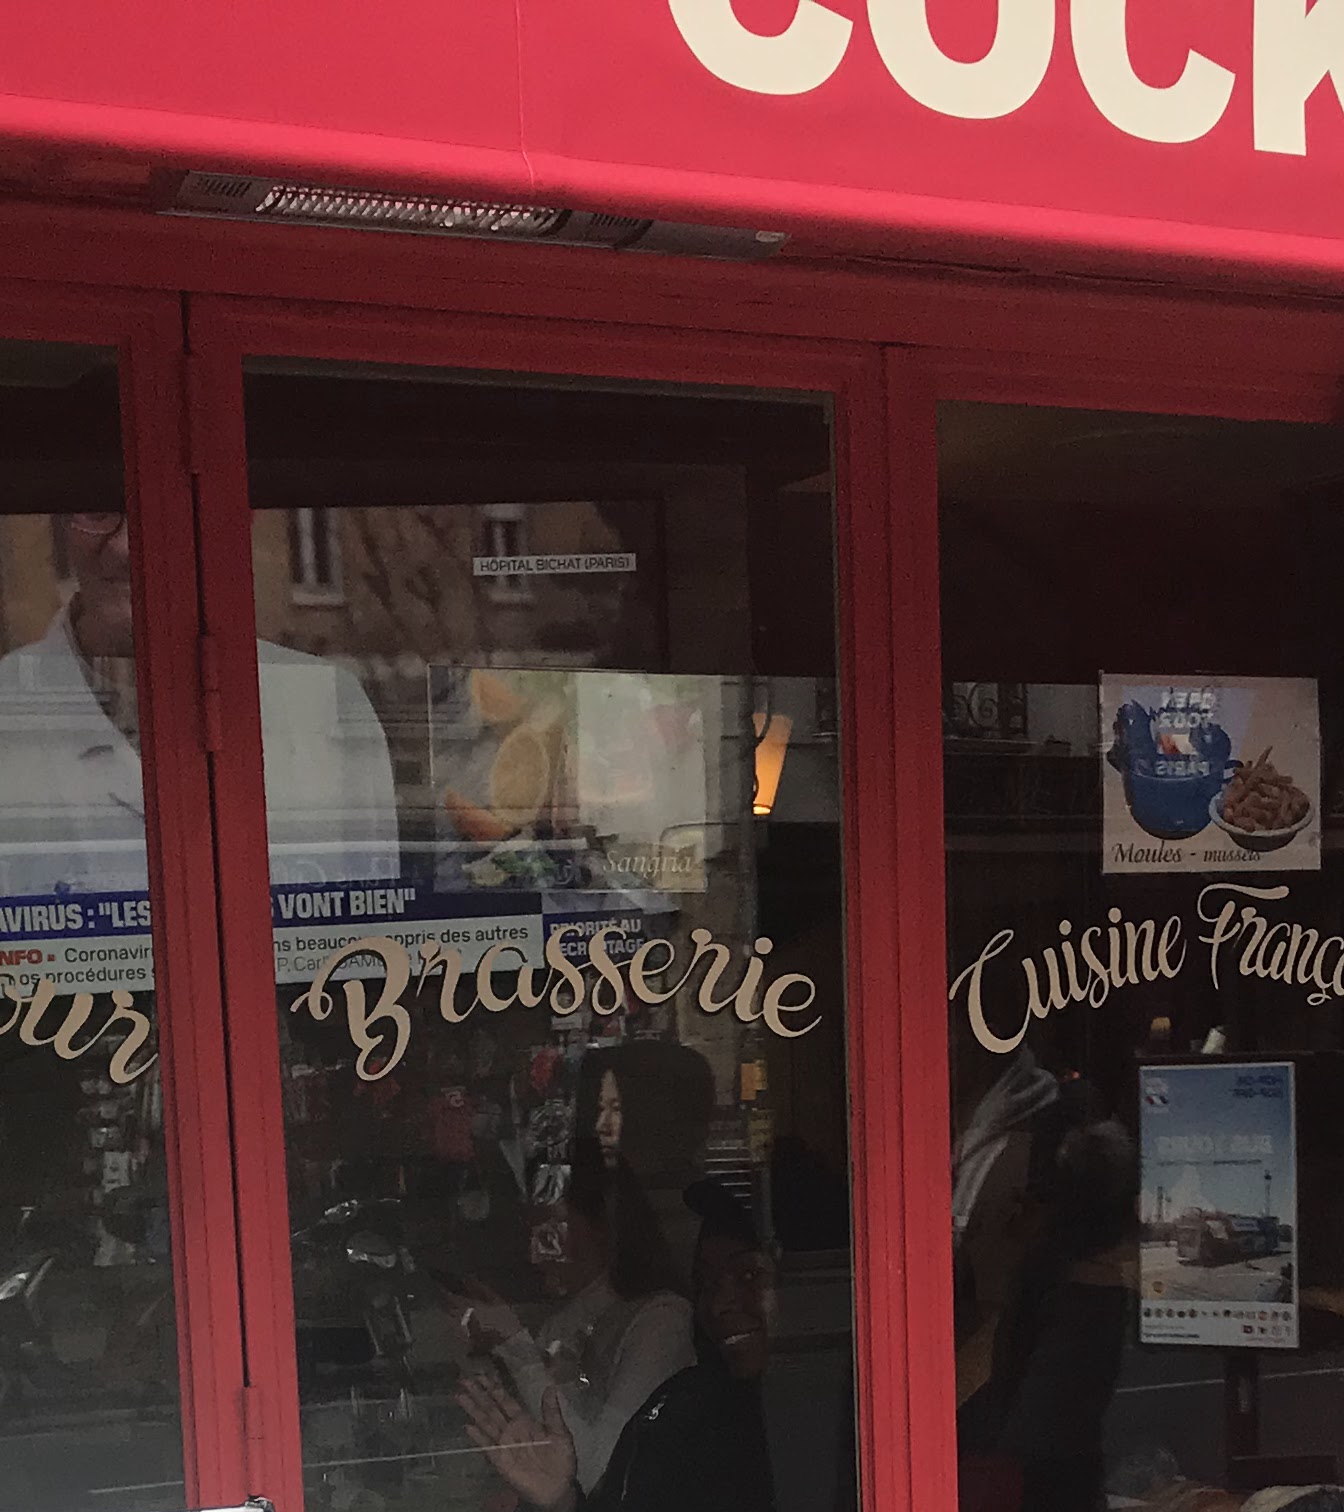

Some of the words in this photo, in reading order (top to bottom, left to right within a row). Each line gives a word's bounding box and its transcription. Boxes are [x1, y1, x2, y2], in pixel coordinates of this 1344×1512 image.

[536, 558, 581, 570] BICHAT
[603, 851, 692, 874] Sangria
[1111, 842, 1182, 863] Moules
[279, 891, 350, 918] VONT
[440, 930, 471, 944] des
[474, 925, 529, 942] autres
[949, 908, 1188, 1054] Cuisine
[290, 928, 822, 1081] Brasserie
